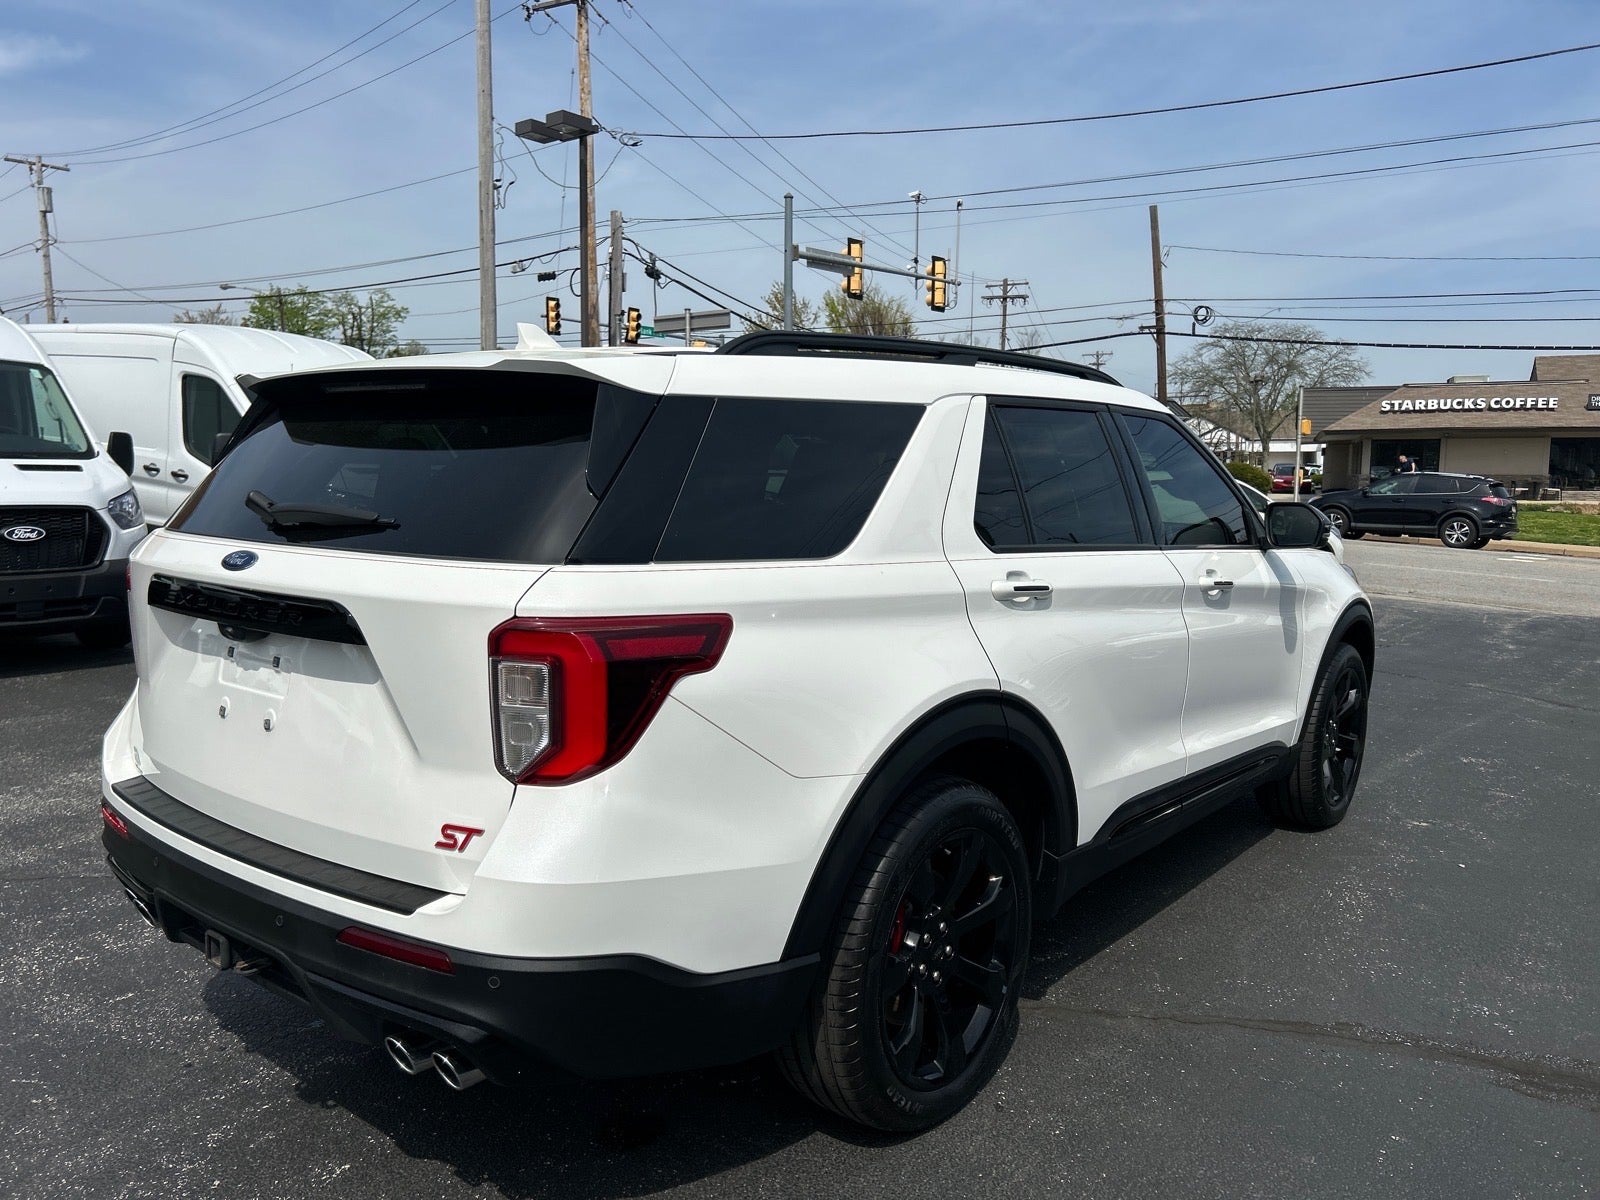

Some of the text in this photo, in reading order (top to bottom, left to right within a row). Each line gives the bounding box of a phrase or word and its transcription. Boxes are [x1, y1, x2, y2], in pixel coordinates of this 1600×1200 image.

[1380, 397, 1559, 411] STARBUCKS COFFEE
[11, 528, 39, 539] Ford
[224, 552, 252, 567] Ford
[164, 585, 303, 625] EXPLORER
[434, 823, 485, 853] ST
